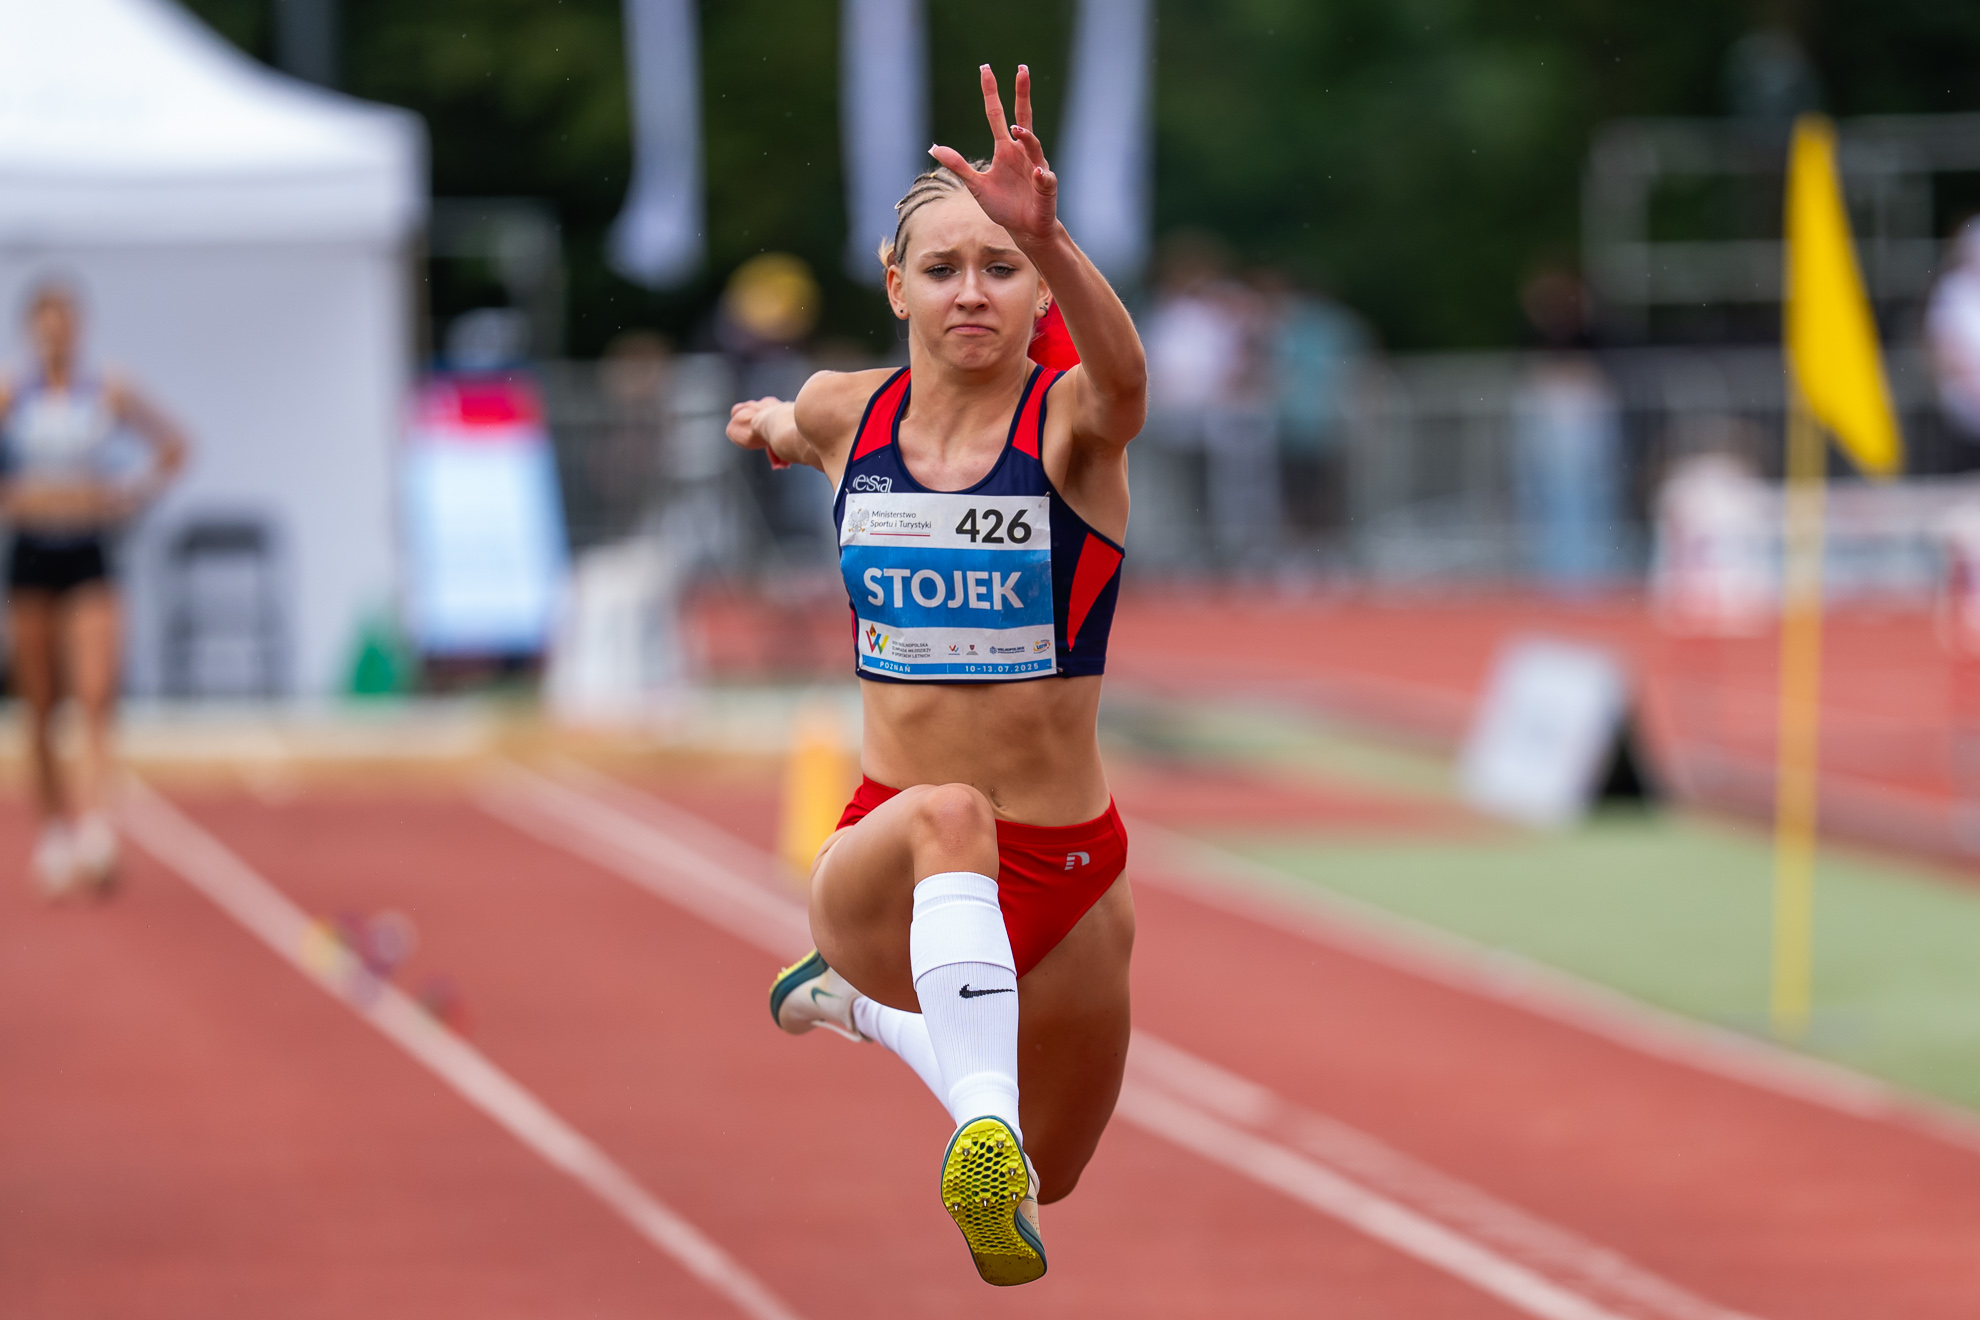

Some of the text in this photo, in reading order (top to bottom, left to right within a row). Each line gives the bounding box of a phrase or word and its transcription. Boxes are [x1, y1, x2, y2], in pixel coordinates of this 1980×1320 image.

[871, 510, 917, 519] Ministerstwo
[870, 519, 893, 528] Sportu
[899, 520, 932, 530] Turystyki
[955, 508, 1032, 544] 426
[863, 567, 1025, 611] STOJEK
[880, 660, 911, 673] POZNAŃ
[965, 662, 1039, 673] 10-13.07.2025
